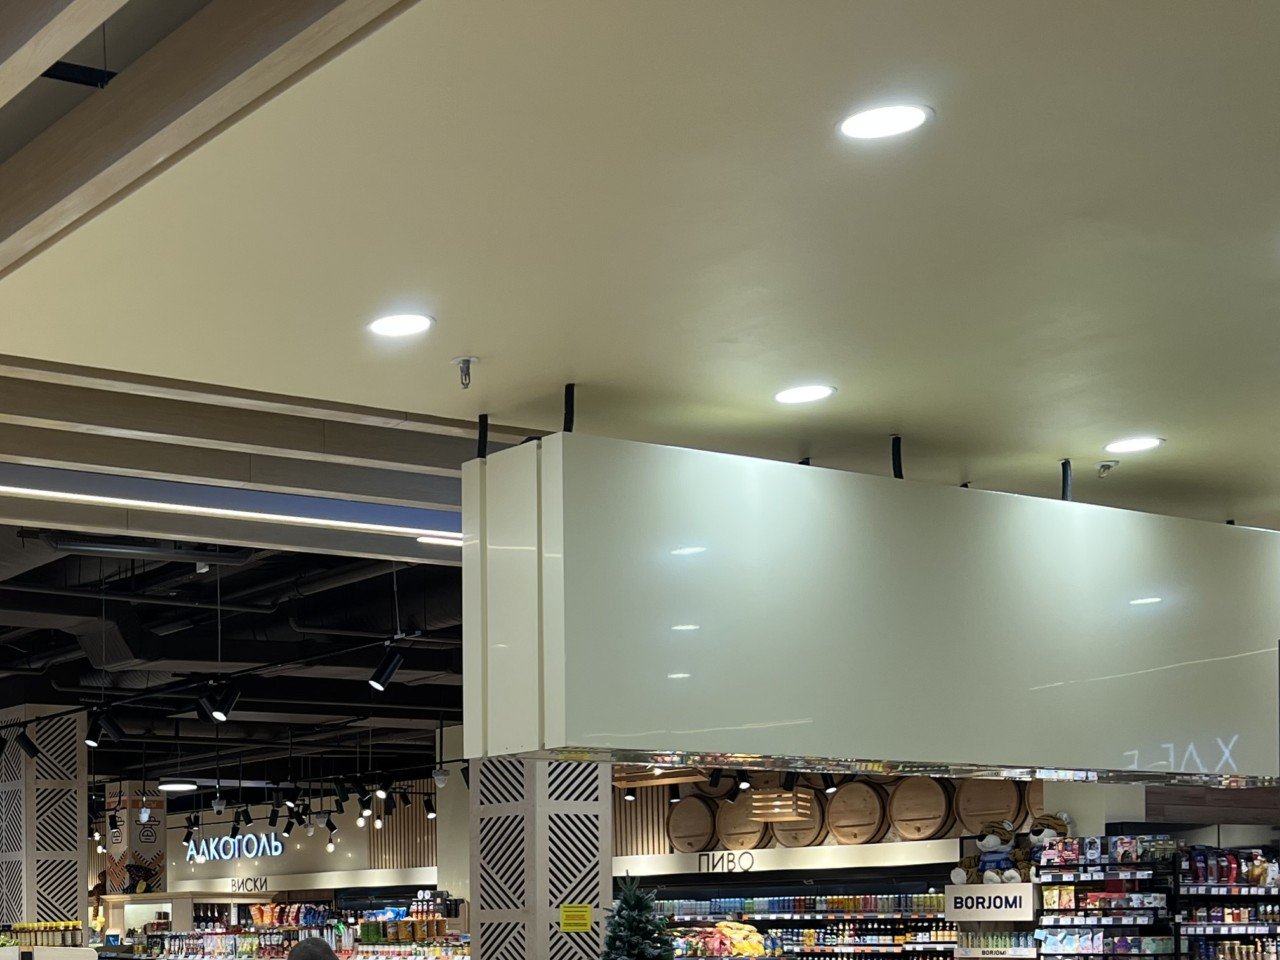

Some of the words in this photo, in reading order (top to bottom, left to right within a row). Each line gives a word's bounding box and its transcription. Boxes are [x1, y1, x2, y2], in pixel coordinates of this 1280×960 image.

[186, 833, 284, 862] АЛКОГОЛЬ
[698, 851, 754, 873] ПИВО
[231, 877, 268, 892] ВИСКИ
[953, 895, 1022, 910] BORJOMI
